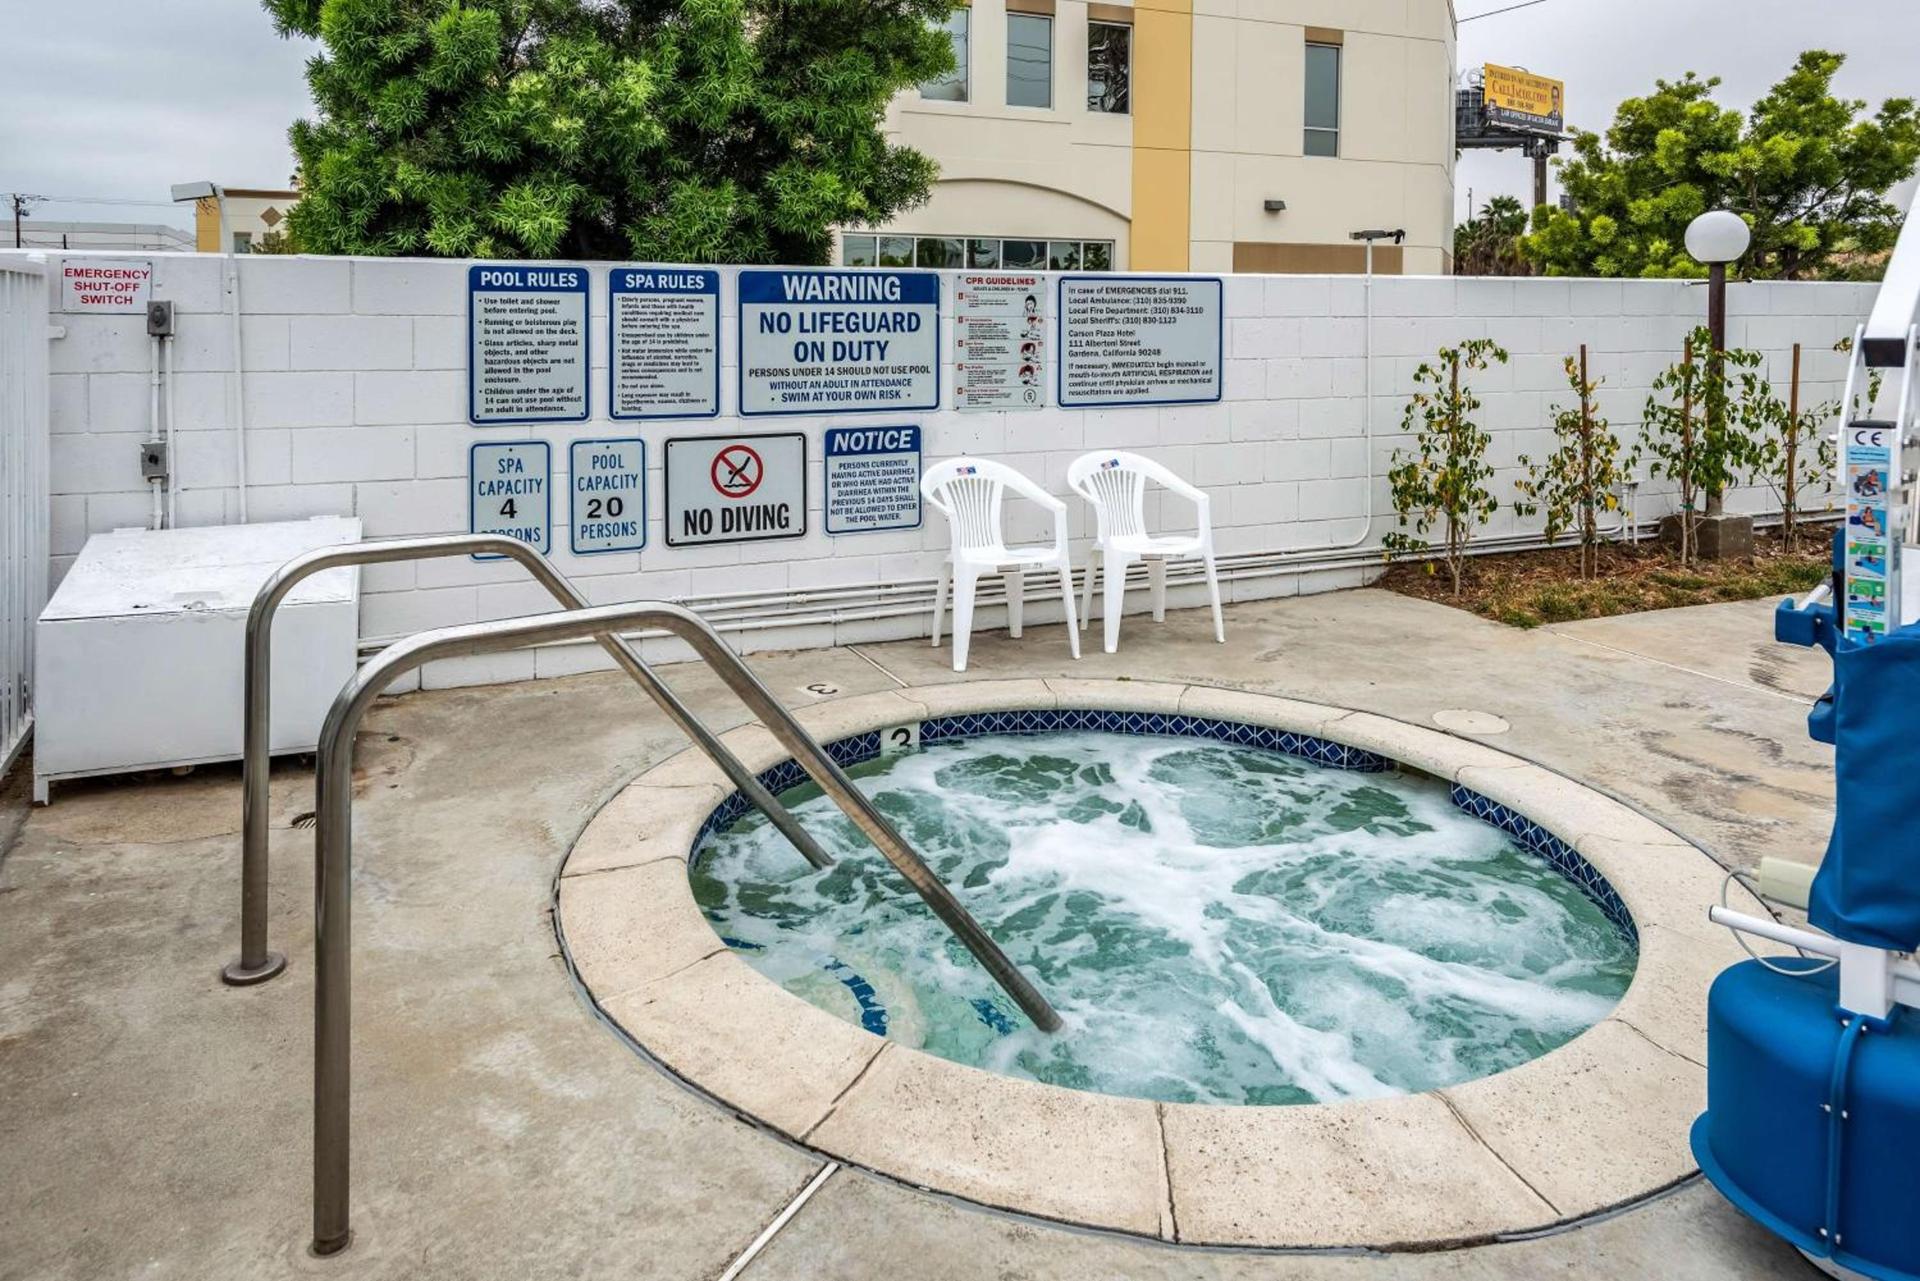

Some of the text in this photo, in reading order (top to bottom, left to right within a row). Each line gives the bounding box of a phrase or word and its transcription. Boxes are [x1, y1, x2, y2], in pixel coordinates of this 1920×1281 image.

[64, 268, 149, 279] EMERGENCY
[481, 272, 578, 287] POOL RULES
[986, 277, 1036, 285] GUIDELINES
[74, 281, 140, 291] SHUT-OFF
[625, 274, 705, 289] SPA RULES
[782, 275, 900, 301] WARNING
[81, 295, 132, 304] SWITCH
[760, 312, 921, 334] NO LIFEGUARD
[794, 340, 890, 362] ON DUTY
[749, 365, 931, 377] PERSONS UNDER 14 SHOULD NOT USE POOL
[770, 378, 912, 390] WITHOUT AN ADULT IN ATTENDANCE
[781, 390, 901, 402] SWIM AT YOUR OWN RISK
[833, 430, 914, 452] NOTICE
[1855, 430, 1882, 447] CE
[498, 458, 523, 474] SPA
[592, 454, 624, 470] POOL
[839, 460, 908, 470] PERSONS CURRENTLY
[832, 468, 915, 479] HAVING ACTIVE DIARRHEA
[478, 478, 543, 496] CAPACITY
[578, 474, 638, 492] CAPACITY
[838, 489, 872, 497] DIARRHEA
[873, 487, 896, 495] WITHIN
[500, 498, 518, 518] 4
[587, 497, 623, 518] 20
[832, 498, 866, 506] PREVIOUS
[855, 505, 886, 513] ALLOWED
[896, 503, 917, 511] ENTER
[683, 503, 790, 536] NO DIVING
[580, 521, 638, 539] PERSONS
[806, 683, 838, 695] 3
